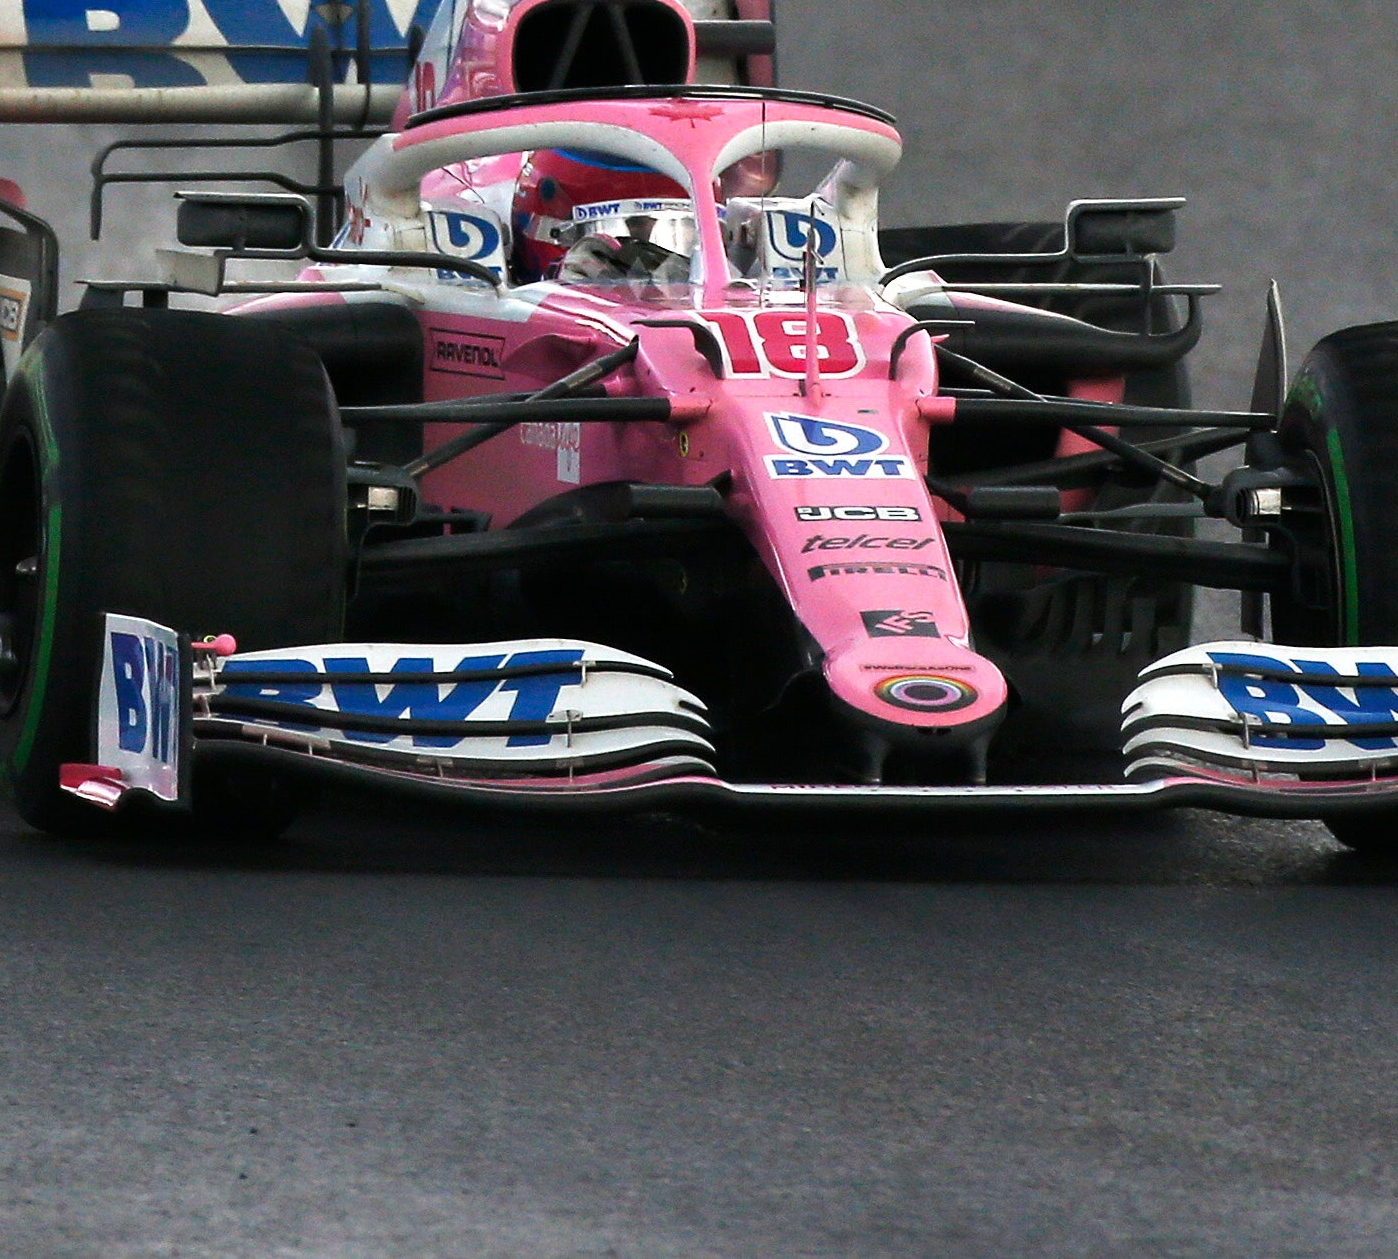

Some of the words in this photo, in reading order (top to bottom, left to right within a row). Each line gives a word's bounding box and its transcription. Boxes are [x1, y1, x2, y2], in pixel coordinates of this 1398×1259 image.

[588, 203, 620, 219] BWT
[436, 340, 499, 368] RAVENOL
[699, 310, 859, 375] 18
[771, 458, 906, 477] BWT
[797, 506, 920, 521] JCB
[213, 649, 586, 748] BWT
